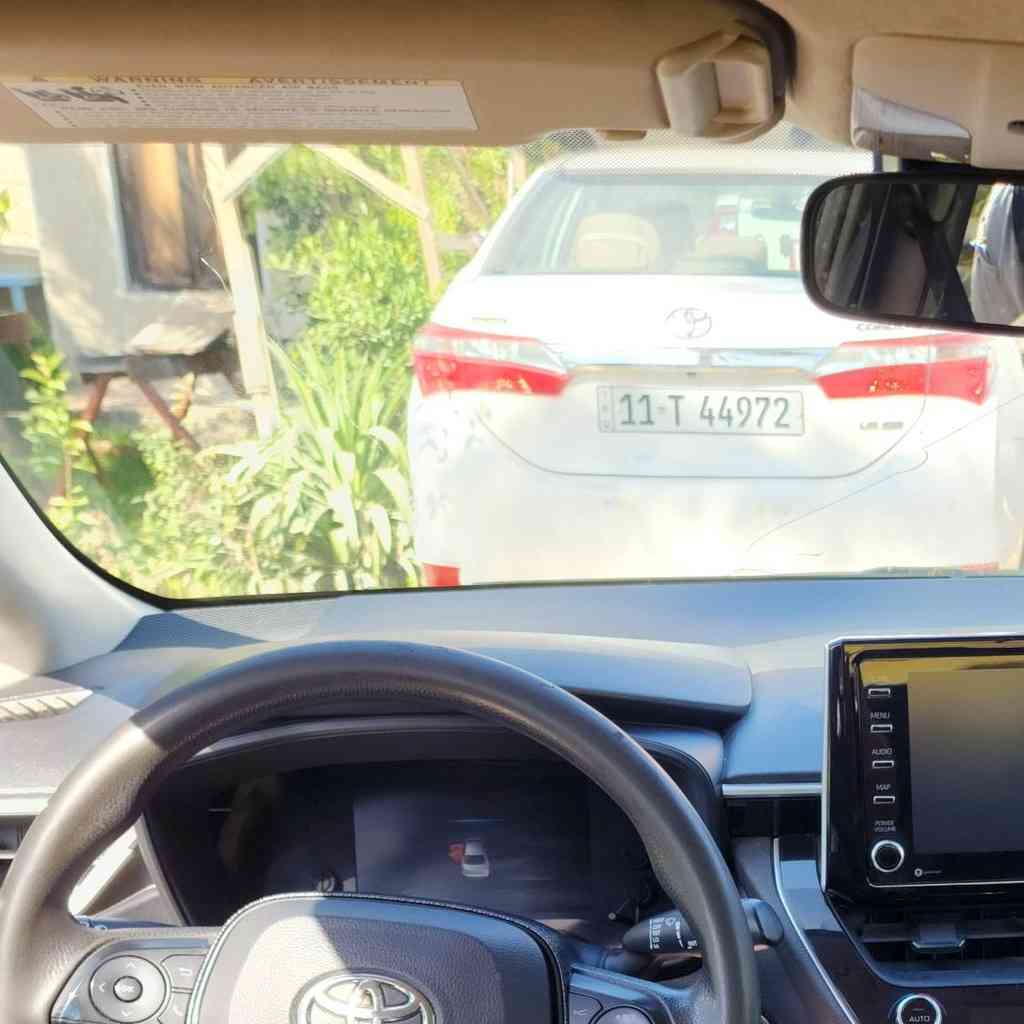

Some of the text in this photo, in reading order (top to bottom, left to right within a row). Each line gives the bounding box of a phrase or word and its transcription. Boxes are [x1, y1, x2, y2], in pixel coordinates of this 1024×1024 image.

[620, 394, 655, 426] 11
[699, 395, 791, 429] 44972
[909, 1015, 930, 1023] AUTO
